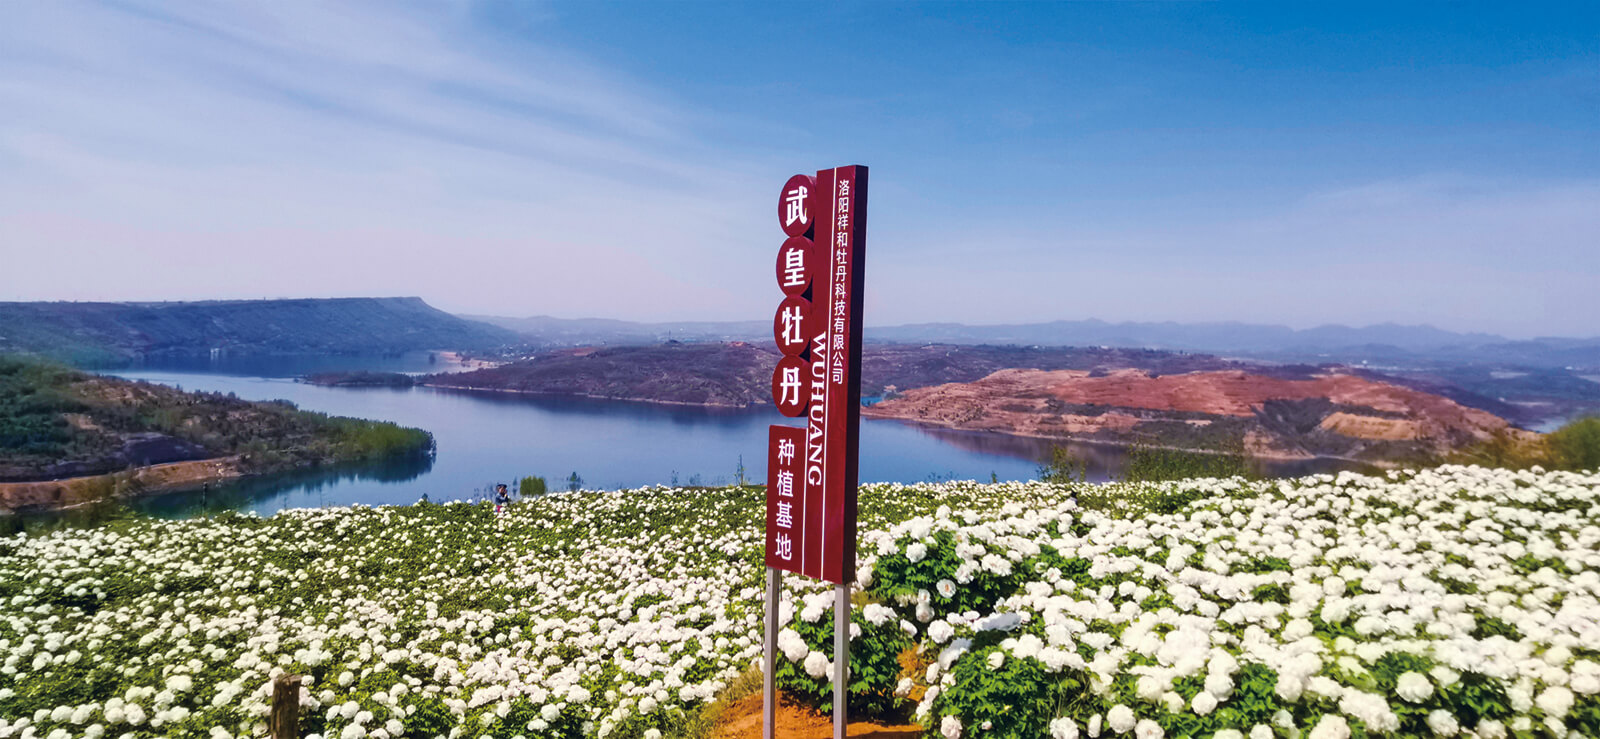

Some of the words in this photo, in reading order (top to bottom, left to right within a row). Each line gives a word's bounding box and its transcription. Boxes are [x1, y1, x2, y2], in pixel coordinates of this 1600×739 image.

[780, 185, 808, 406] 武皇牡丹
[832, 179, 850, 385] 洛阳祥和牡丹科技有限公司
[808, 331, 827, 486] WUHUANG
[775, 438, 795, 561] 种植基地
